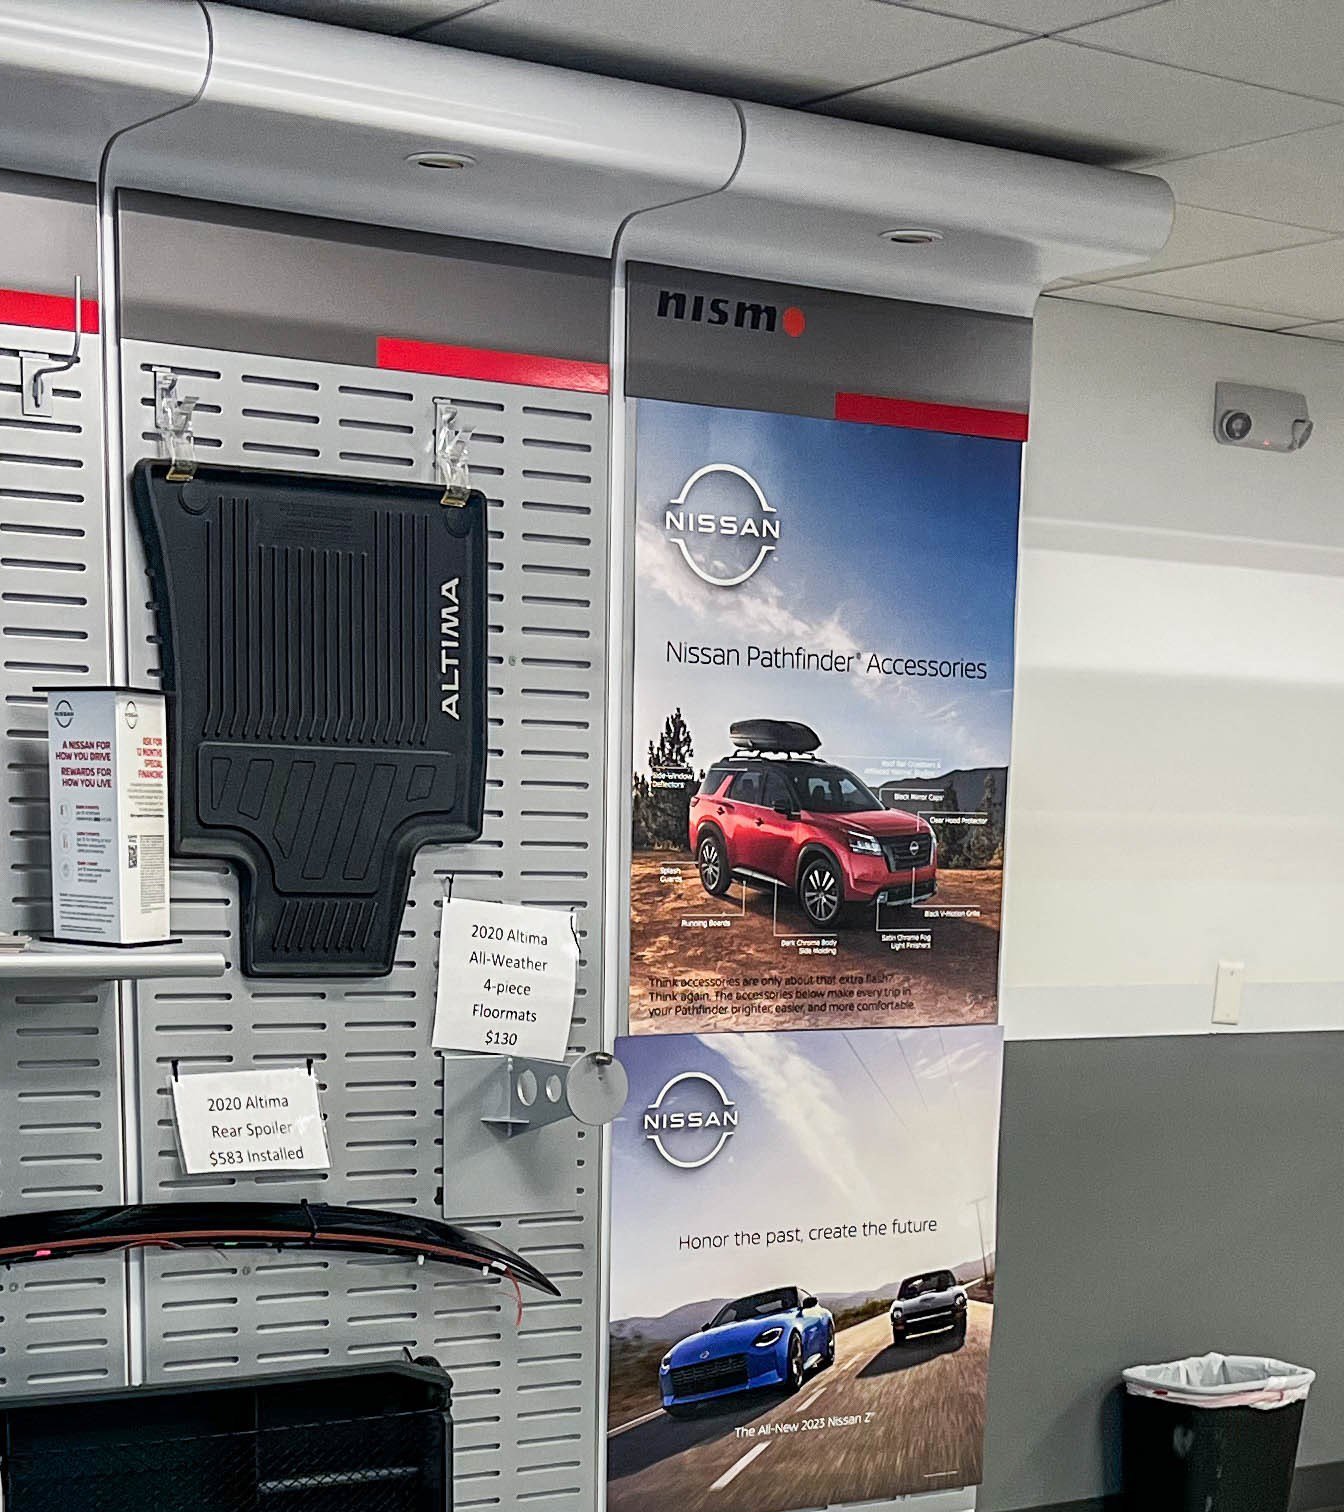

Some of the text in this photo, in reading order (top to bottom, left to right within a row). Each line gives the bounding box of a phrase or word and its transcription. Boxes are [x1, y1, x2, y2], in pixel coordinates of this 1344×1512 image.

[665, 510, 780, 539] NISSAN
[441, 577, 460, 721] ALTIMA
[666, 640, 740, 666] Nissan
[866, 653, 987, 680] Accessories
[62, 741, 111, 750] A NISSAN FOR
[56, 752, 111, 761] HOW YOU DRIVE
[61, 767, 111, 776] REWARDS FOR
[63, 779, 112, 788] HOW YOU LIVE
[471, 924, 548, 946] 2020 Altima
[469, 951, 548, 971] All-Weather
[483, 978, 531, 995] 4-piece
[648, 976, 679, 987] Think
[680, 977, 740, 988] accessories
[742, 978, 759, 987] are
[760, 975, 782, 988] only
[784, 975, 814, 986] about
[816, 974, 836, 986] that
[838, 974, 864, 985] extra
[649, 986, 912, 1003] Think again. The accessories below make every trip in
[472, 1003, 537, 1022] Floormats
[648, 1006, 672, 1018] your
[675, 1004, 728, 1016] Pathfinder
[731, 1003, 773, 1016] brighter,
[775, 1003, 806, 1014] easier,
[808, 1001, 827, 1013] and
[828, 1002, 855, 1012] more
[485, 1030, 518, 1046] $130
[208, 1095, 289, 1112] 2020 Altima
[644, 1110, 738, 1130] NISSAN
[211, 1121, 293, 1139] Rear Spoiler
[209, 1146, 304, 1167] $583 Installed
[679, 1218, 938, 1251] Honor the past, create the future
[734, 1426, 755, 1438] The
[757, 1421, 799, 1436] All-New
[801, 1419, 826, 1431] 2023
[828, 1414, 862, 1428] Nissan
